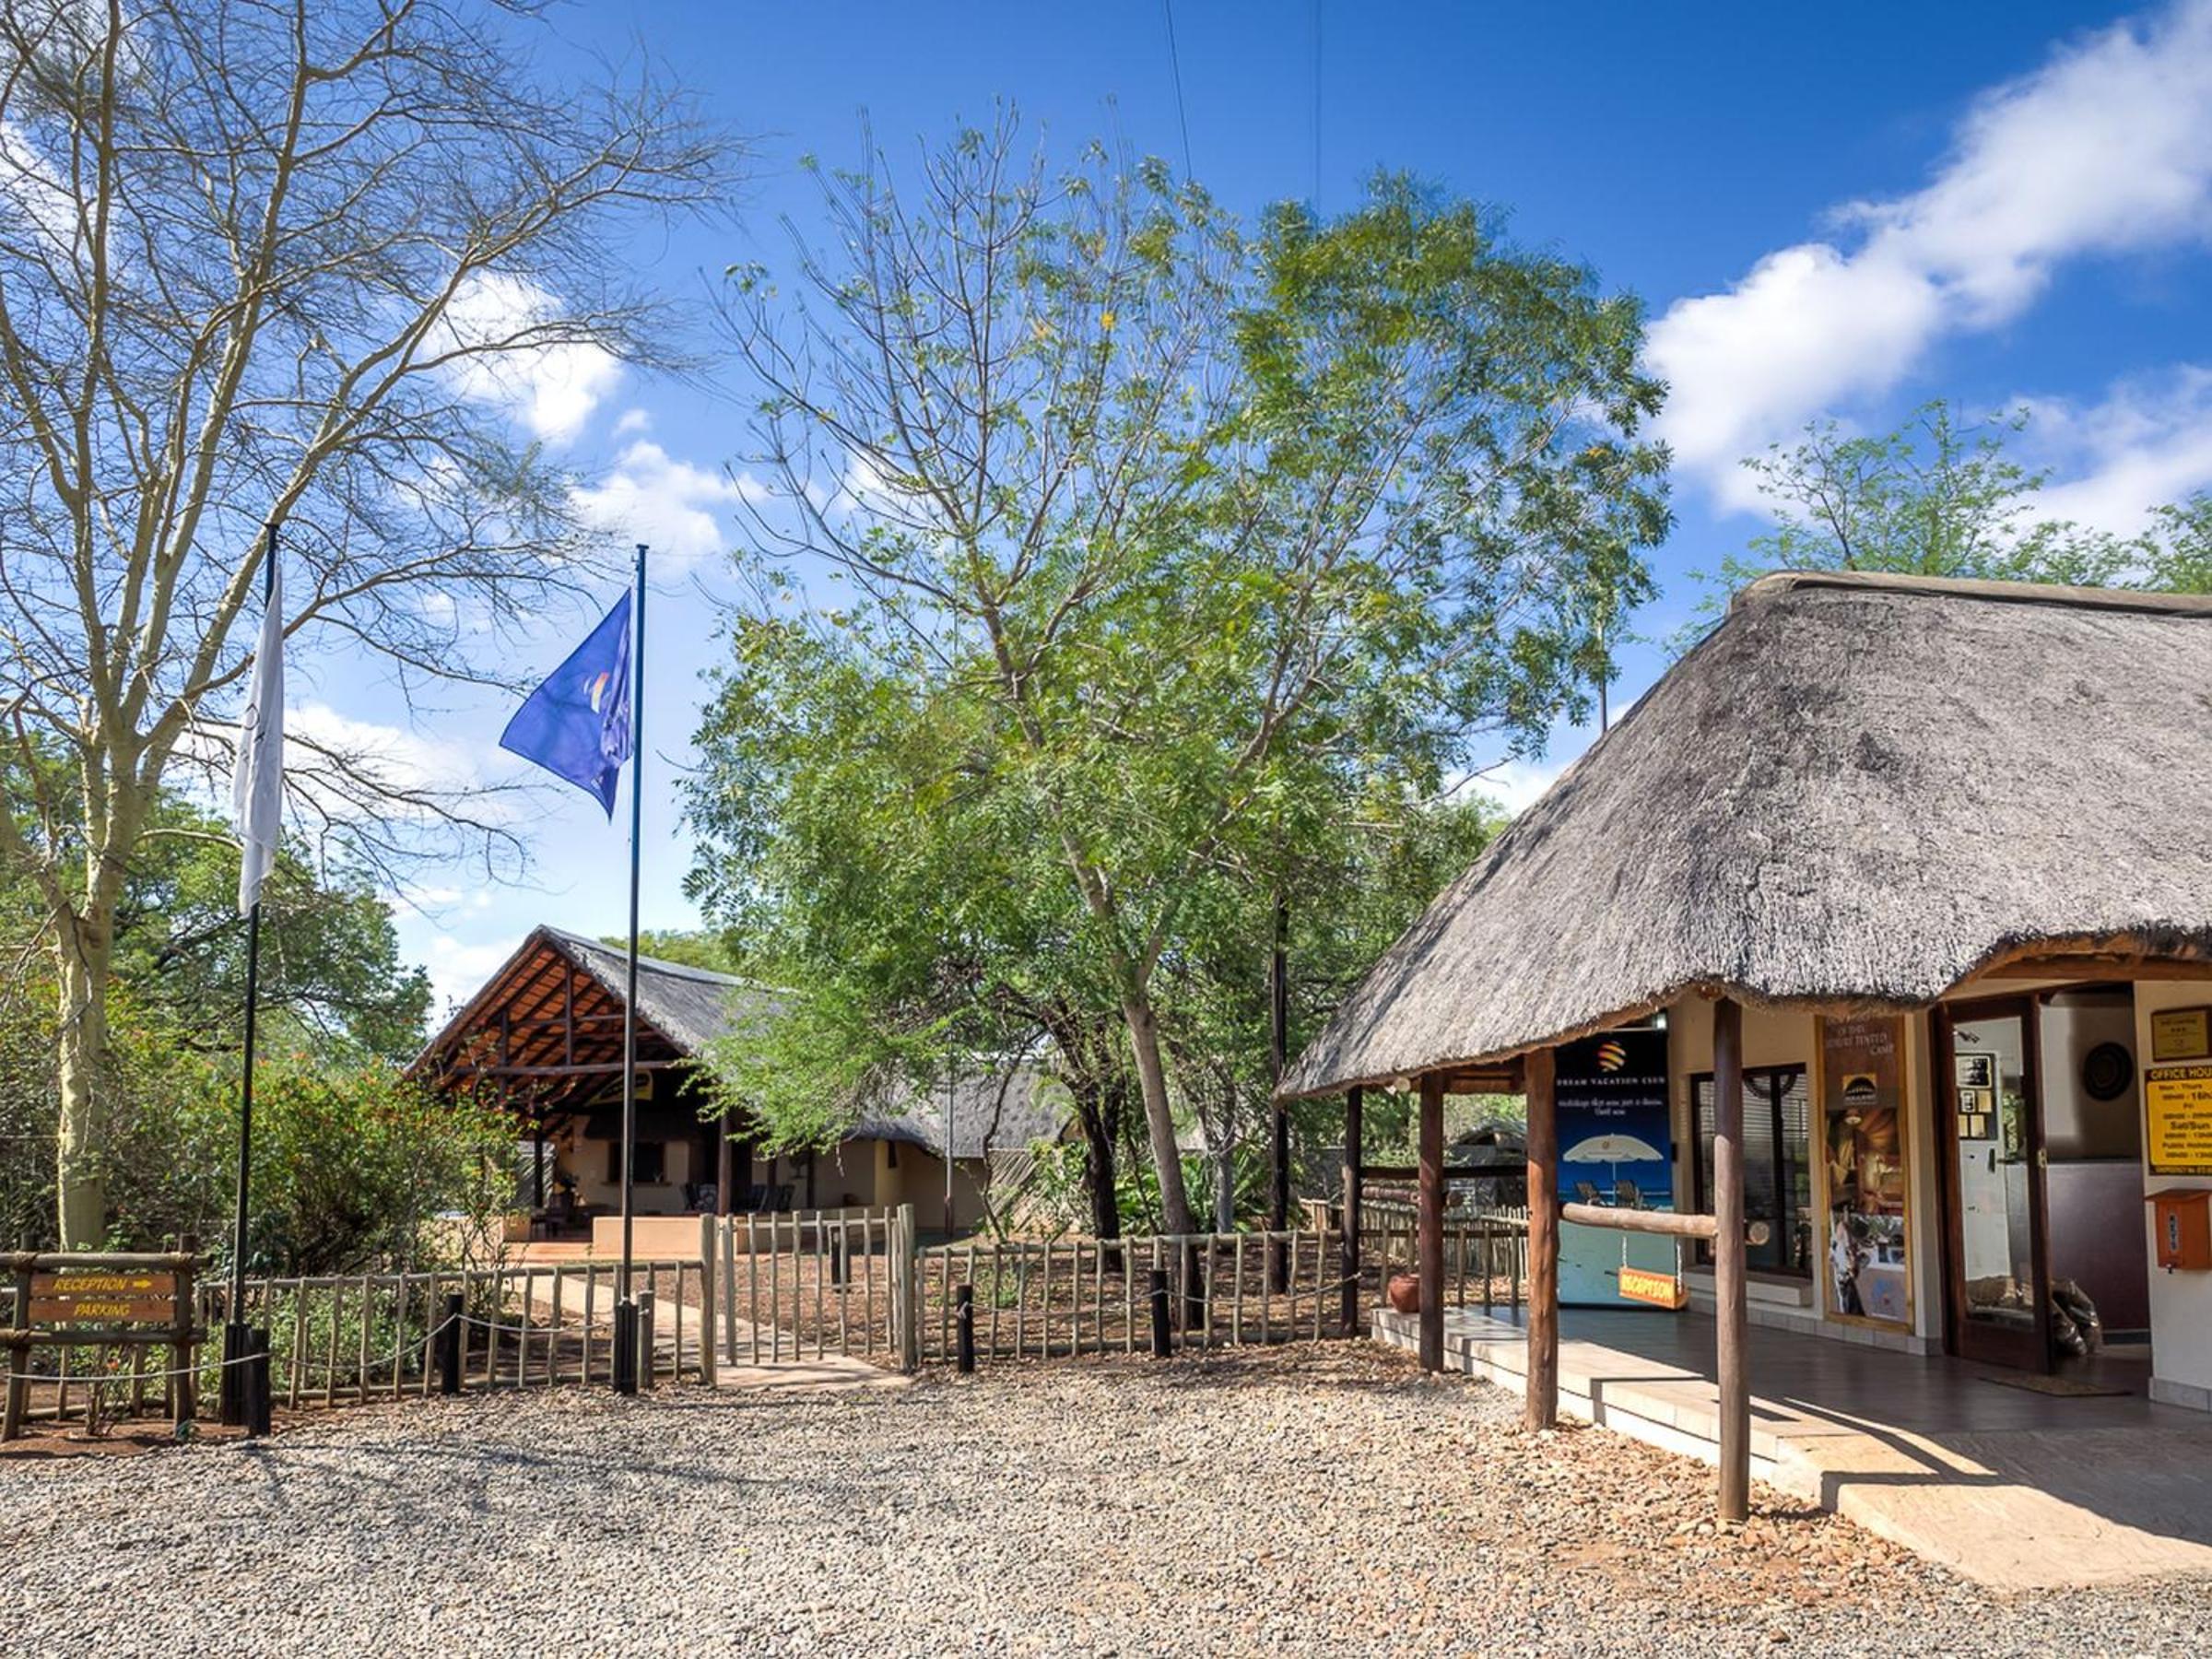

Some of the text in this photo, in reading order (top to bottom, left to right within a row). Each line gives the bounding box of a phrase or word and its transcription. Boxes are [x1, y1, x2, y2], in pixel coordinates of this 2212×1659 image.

[2150, 1066, 2212, 1079] OFFICE HOU
[1556, 1076, 1665, 1087] DREAM VACATION CLUB
[53, 1277, 128, 1291] RECEPTION
[1621, 1274, 1675, 1300] RECEPTION
[73, 1300, 131, 1317] PARKING
